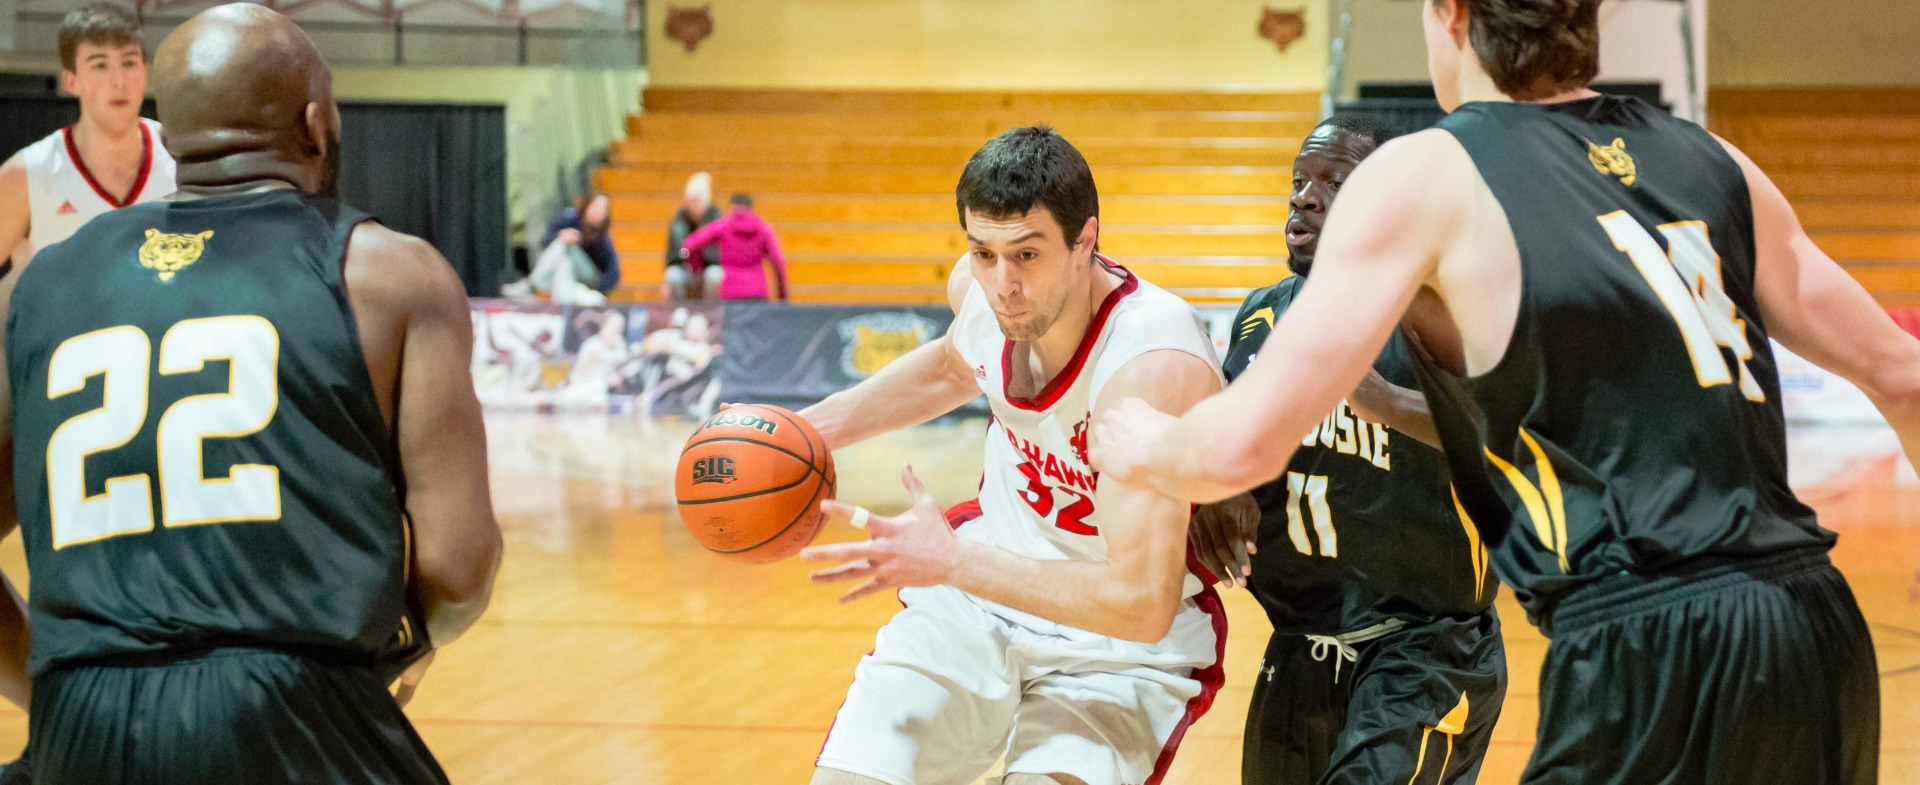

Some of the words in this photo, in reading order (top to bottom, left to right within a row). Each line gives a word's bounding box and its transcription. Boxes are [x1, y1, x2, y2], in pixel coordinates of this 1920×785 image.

[1596, 209, 1766, 403] 14
[46, 314, 282, 551] 22
[692, 455, 735, 480] SIC
[1015, 461, 1100, 537] 32
[1286, 471, 1338, 559] 11
